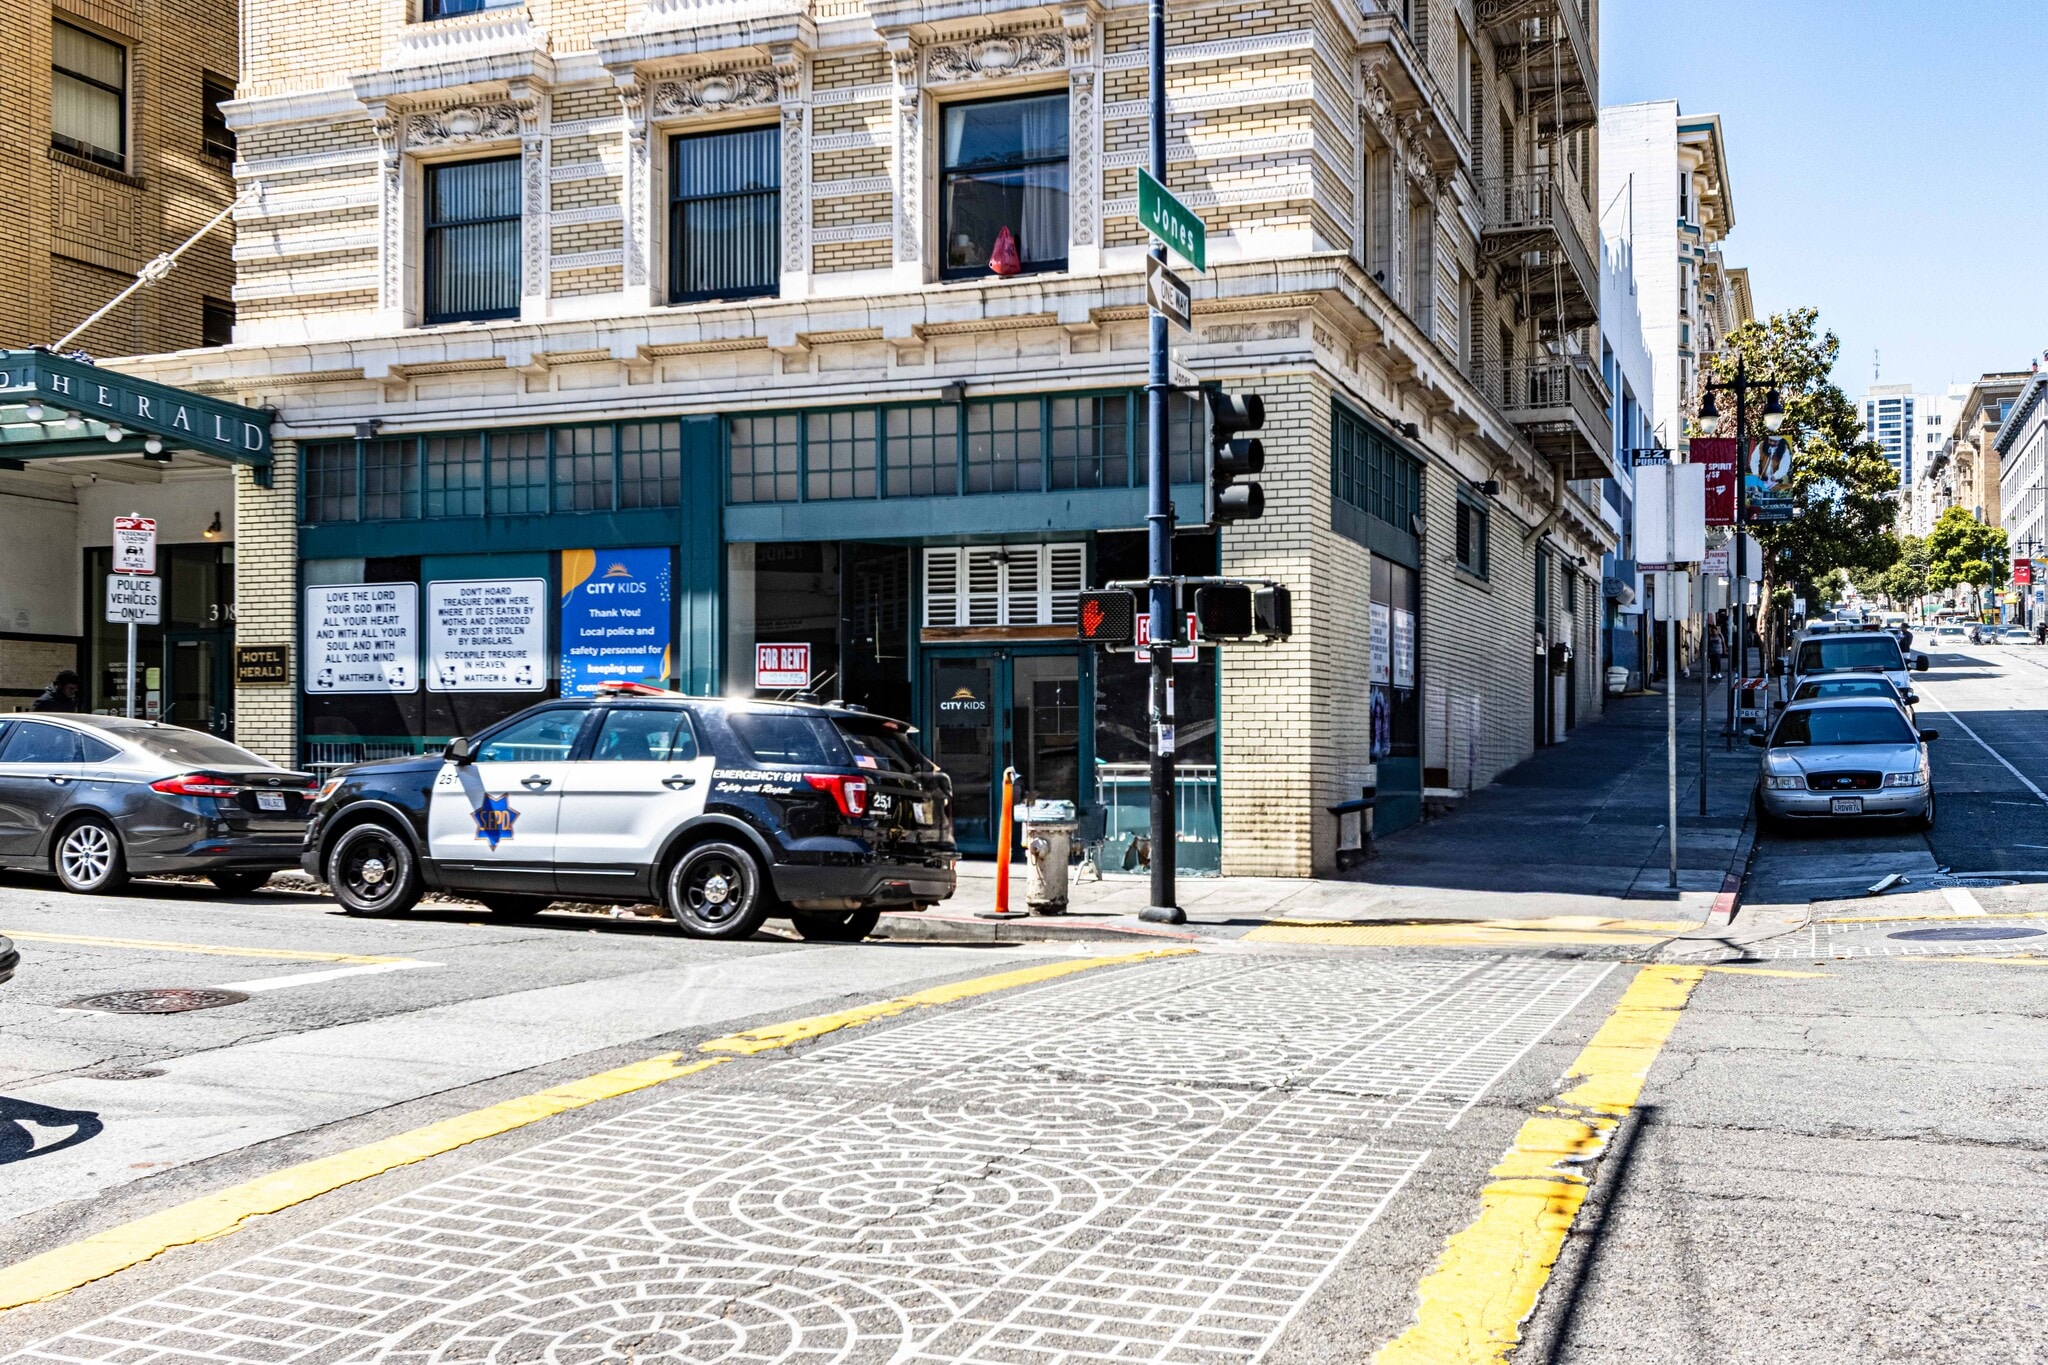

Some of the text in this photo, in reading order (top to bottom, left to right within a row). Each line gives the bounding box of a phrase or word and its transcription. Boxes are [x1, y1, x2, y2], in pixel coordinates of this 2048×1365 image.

[1153, 197, 1194, 251] Jones
[1161, 280, 1188, 315] ONE WAY
[1208, 322, 1257, 343] EDDY
[1174, 368, 1191, 386] Jones
[51, 373, 263, 451] HERALD
[1639, 450, 1664, 458] EZ
[117, 580, 151, 591] POLICE
[587, 582, 646, 594] CITY KIDS
[327, 591, 395, 602] LOVE THE LORD
[461, 587, 512, 596] DON'T HOARD
[111, 593, 157, 606] VEHICLES
[443, 598, 481, 606] TREASURE
[509, 597, 529, 605] HERE
[121, 608, 146, 618] ONLY
[327, 604, 396, 614] YOUR GOD WITH
[438, 608, 463, 616] WHERE
[497, 607, 520, 615] EATEN
[589, 608, 641, 618] Thank You!
[323, 616, 399, 626] ALL YOUR HEART
[442, 618, 467, 626] MOTHS
[489, 617, 530, 625] CORRODED
[316, 628, 406, 639] AND WITH ALL YOUR
[448, 628, 458, 636] BY
[483, 627, 493, 635] OR
[580, 627, 655, 637] Local police and
[327, 641, 395, 651] SOUL AND WITH
[472, 637, 513, 645] BURGLARS.
[445, 650, 527, 659] STOCKPILE TREASURE
[570, 645, 662, 656] safety personnel for
[242, 652, 280, 662] HOTEL
[325, 653, 397, 663] ALL YOUR MIND.
[760, 648, 806, 670] FOR RENT
[240, 666, 283, 677] HERALD
[587, 664, 644, 675] keeping our
[339, 674, 374, 682] MATTHEW
[941, 701, 985, 710] CITY KIDS
[439, 774, 459, 784] 251
[713, 769, 780, 782] EMERGENCY
[783, 773, 801, 782] 911
[715, 782, 793, 795] Safety with Respect
